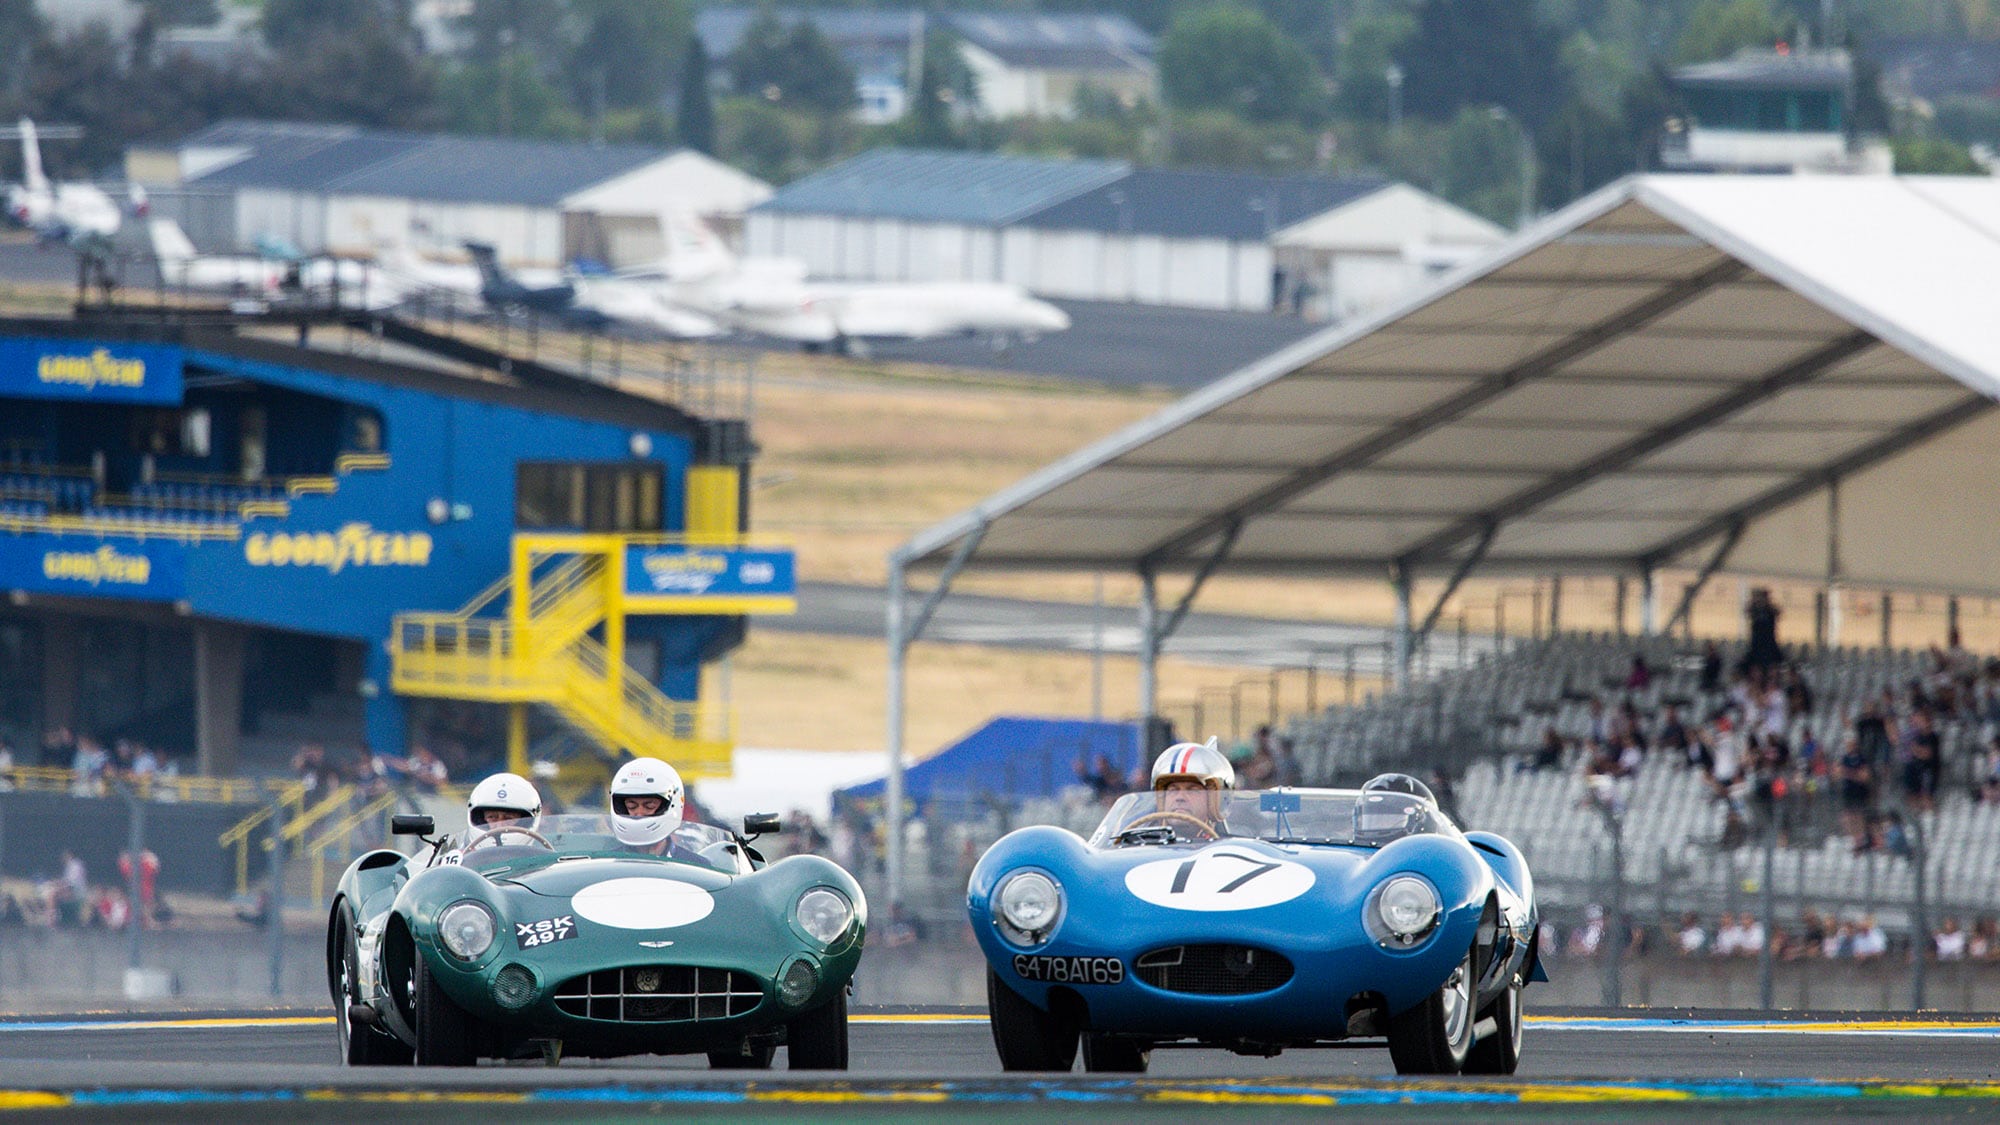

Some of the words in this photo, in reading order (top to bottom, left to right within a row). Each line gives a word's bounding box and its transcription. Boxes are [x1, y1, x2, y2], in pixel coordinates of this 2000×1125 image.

[245, 523, 433, 573] GOODYEAR
[1170, 853, 1282, 894] 17
[515, 915, 574, 936] XSK
[524, 927, 569, 947] 497
